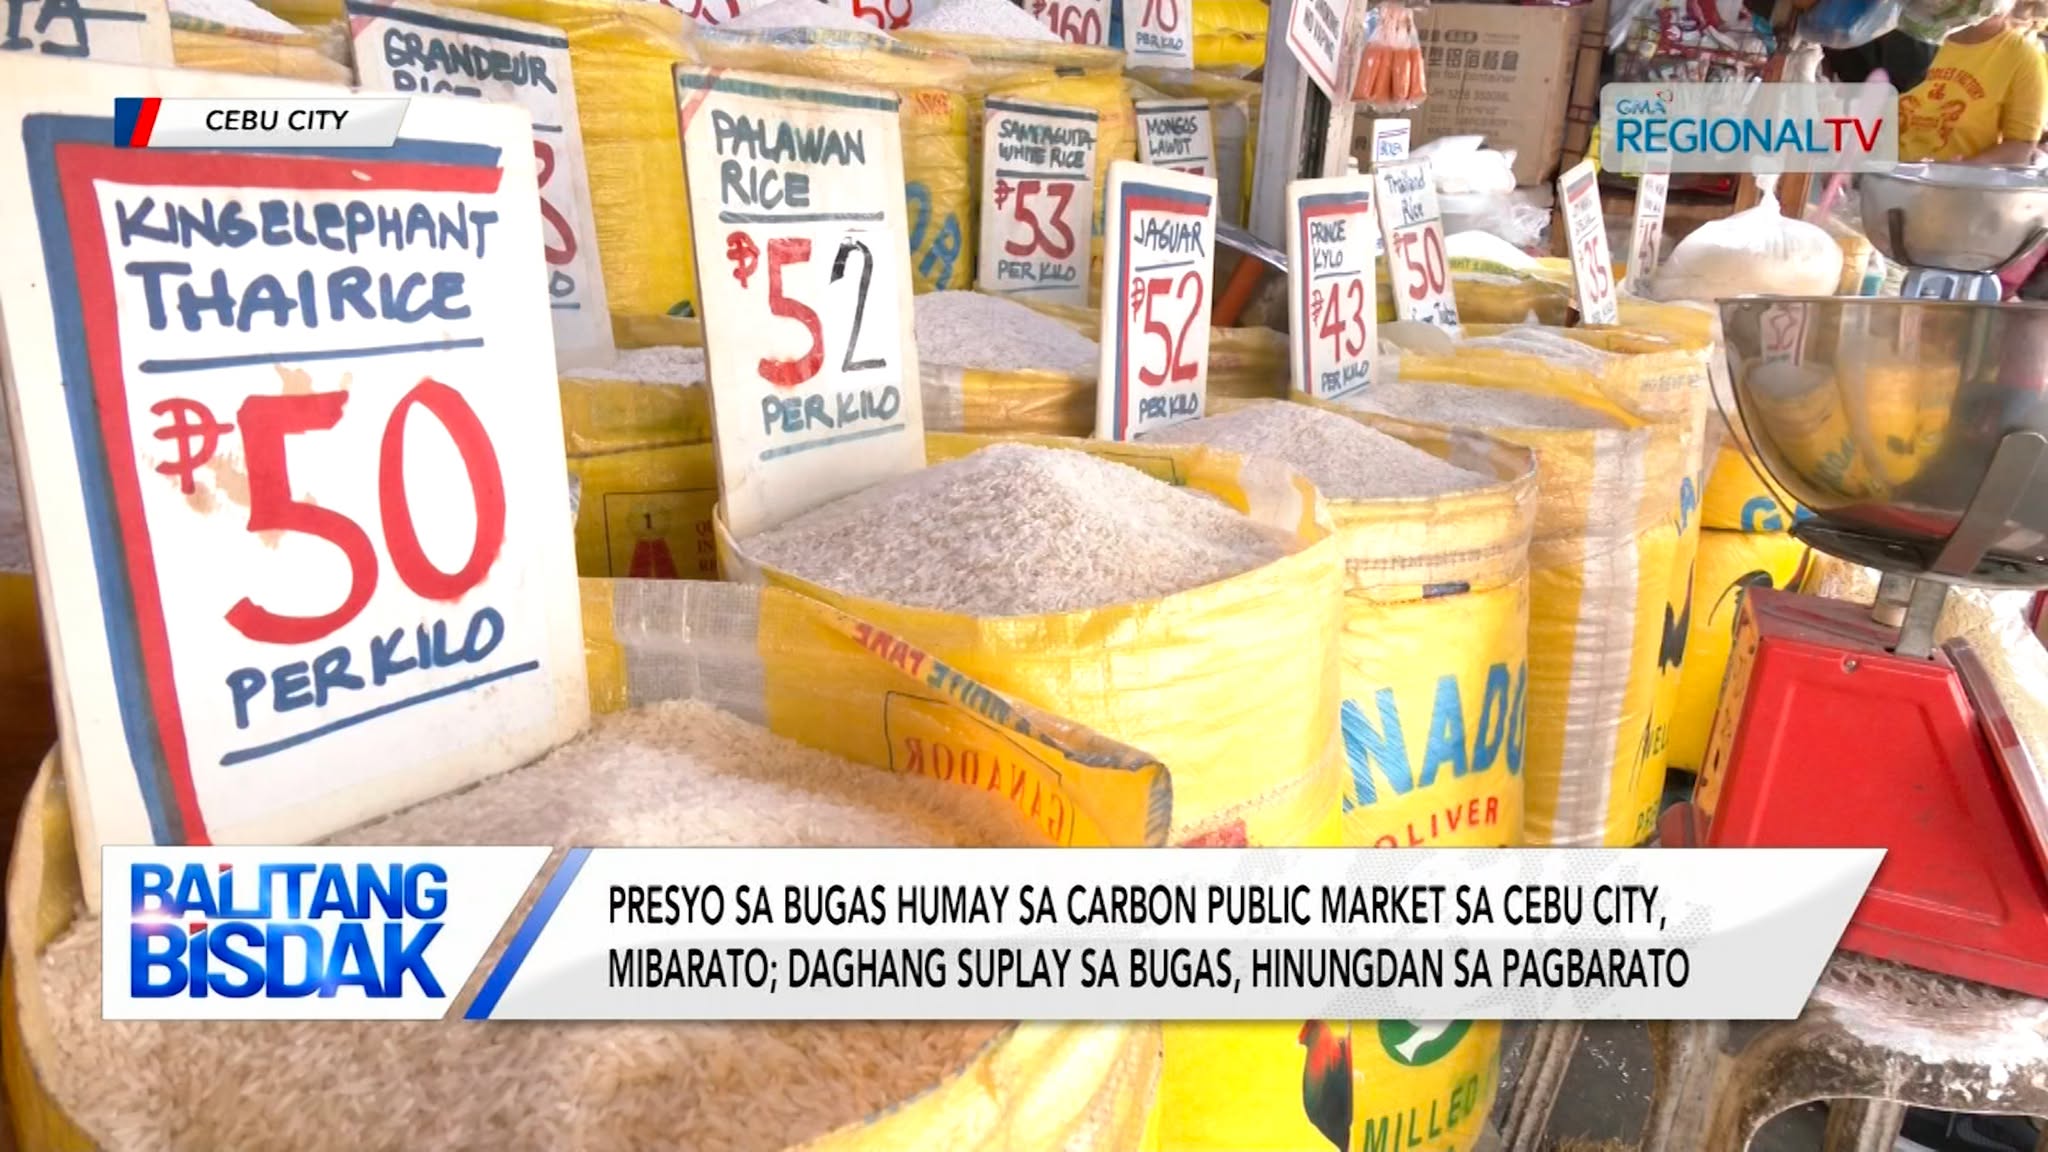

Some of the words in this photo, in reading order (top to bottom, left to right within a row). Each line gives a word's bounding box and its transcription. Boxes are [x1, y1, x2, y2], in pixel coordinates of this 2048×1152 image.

[384, 28, 557, 93] GRANDEUR
[712, 109, 866, 165] PALAWAN
[999, 142, 1046, 164] WHITE
[1050, 149, 1084, 168] RICE
[720, 160, 810, 210] RICE
[1134, 216, 1205, 258] JAGUAR
[1309, 219, 1347, 244] PRINCE
[998, 260, 1035, 281] PER
[1039, 261, 1076, 282] KILO
[1312, 250, 1344, 273] KYLO
[1320, 371, 1342, 394] PER
[1138, 397, 1166, 424] PER
[1363, 1073, 1480, 1152] MILLED
